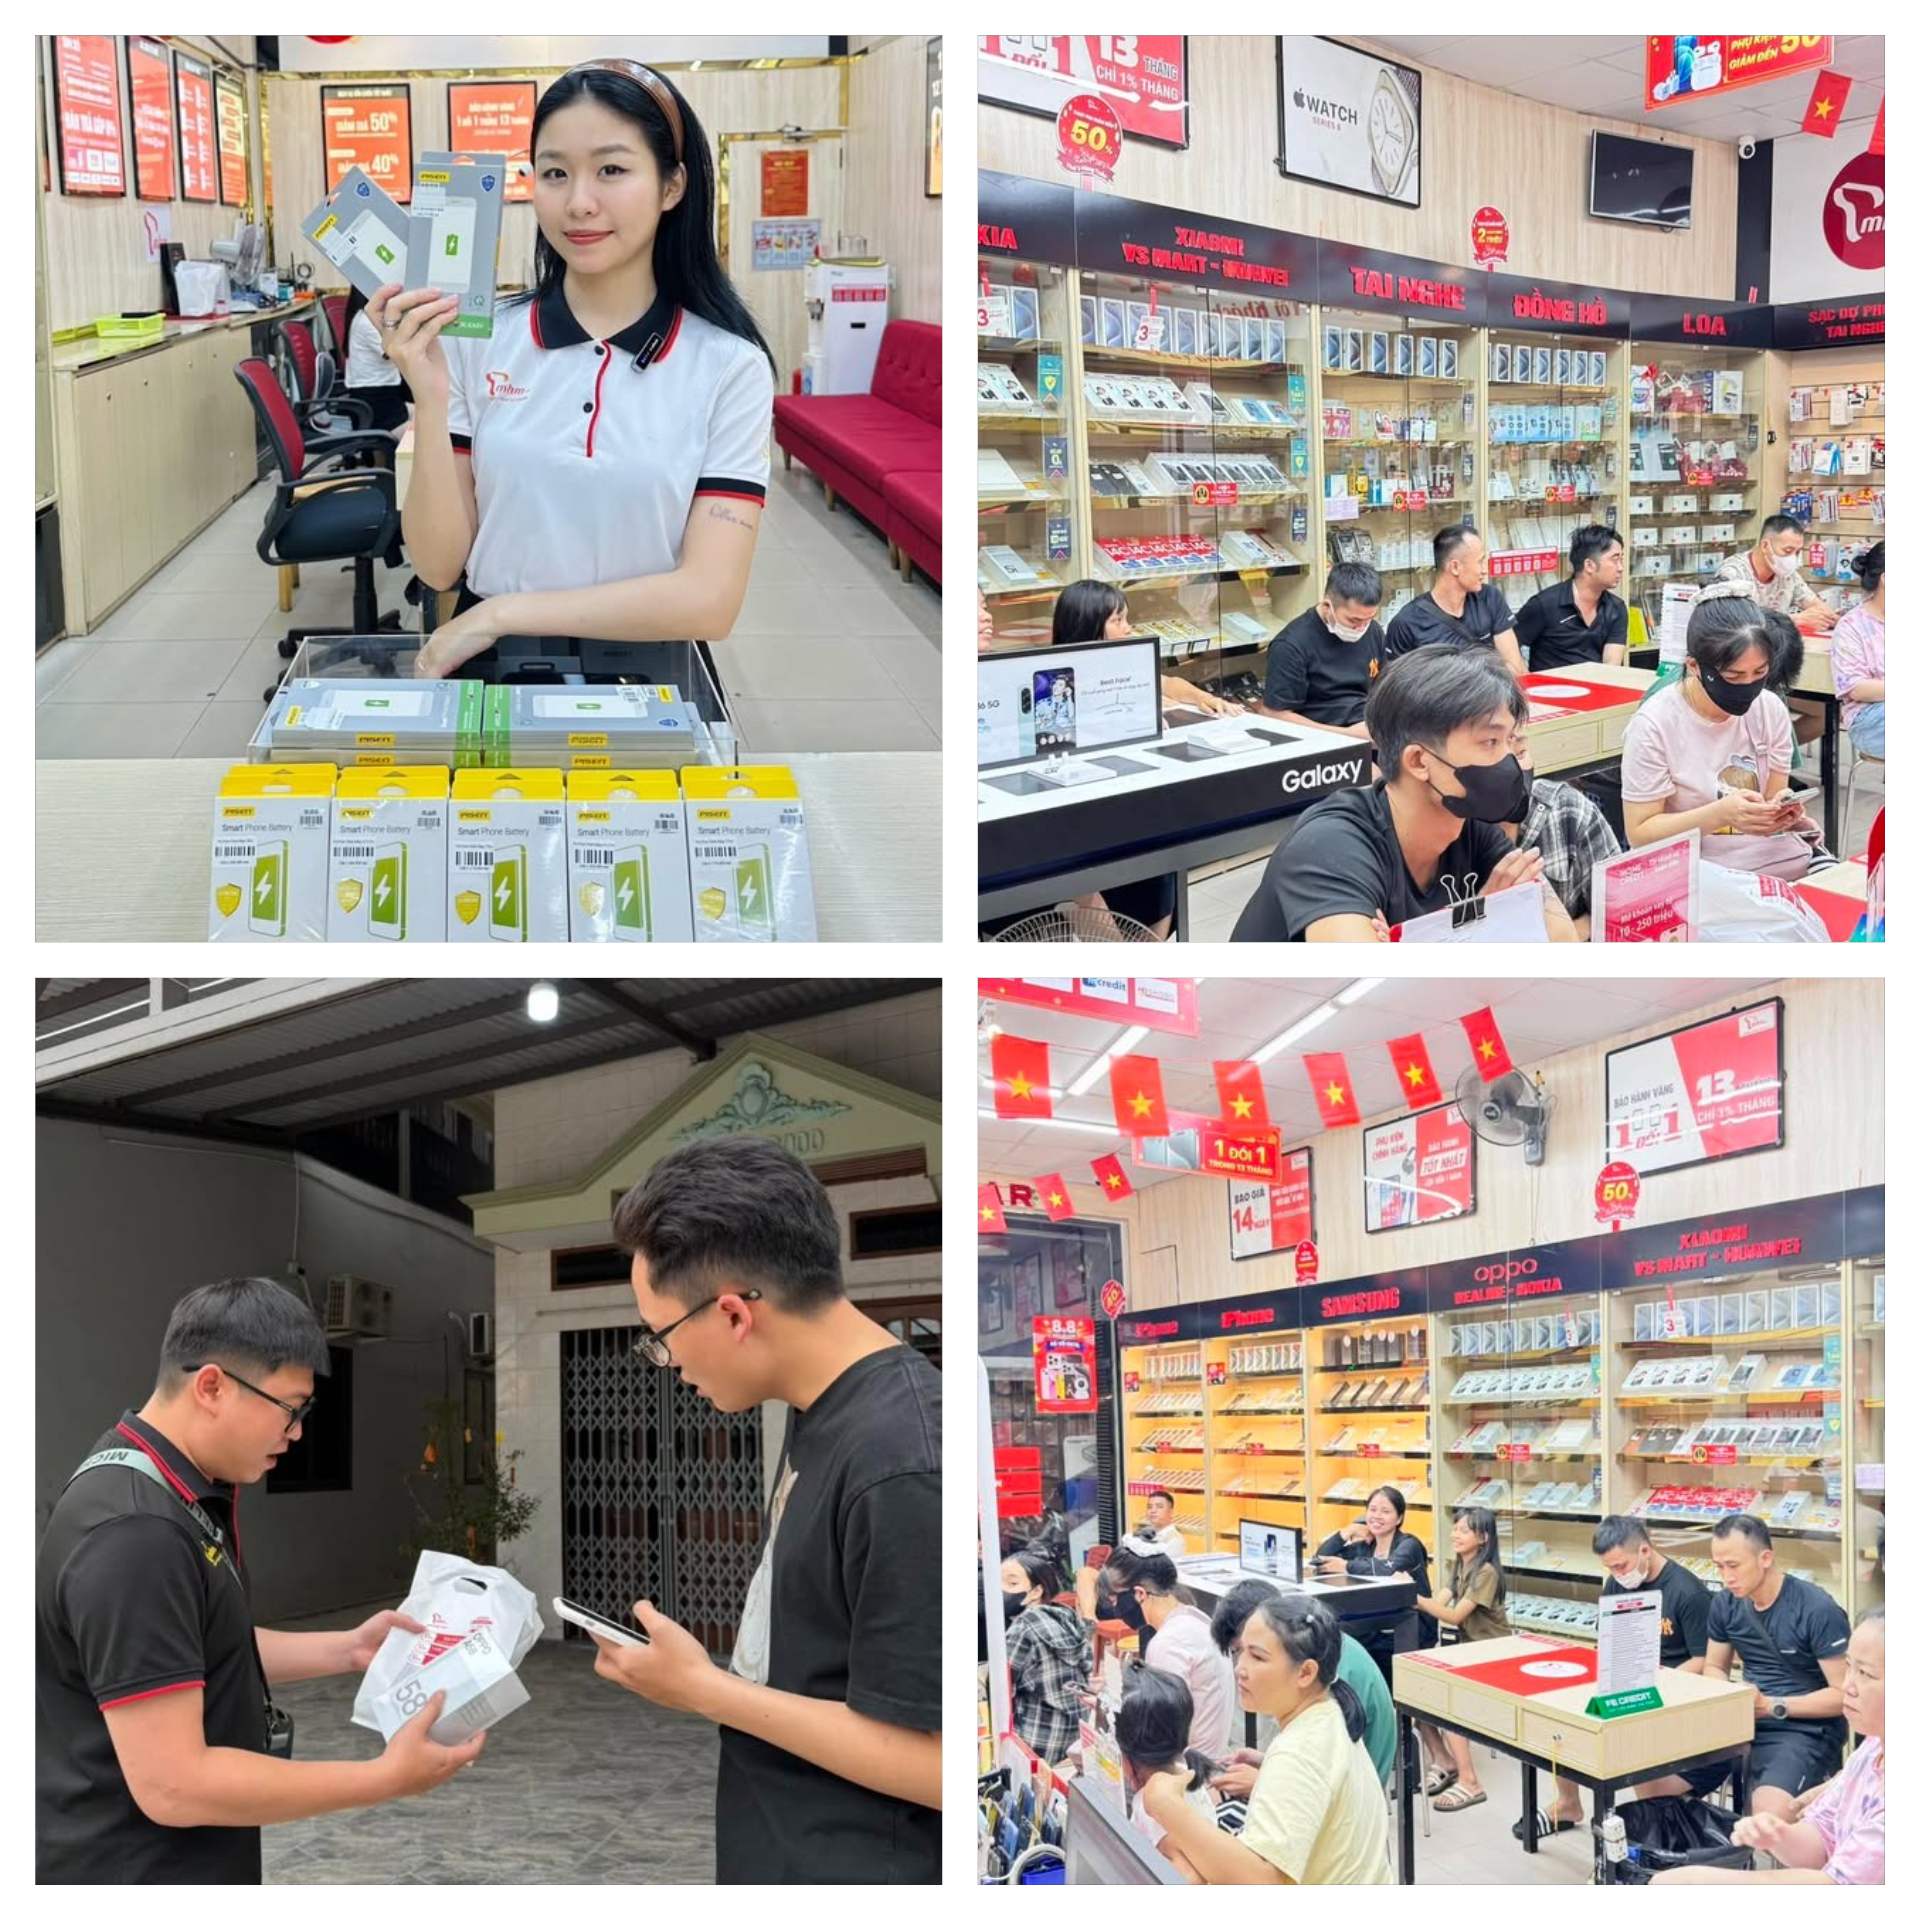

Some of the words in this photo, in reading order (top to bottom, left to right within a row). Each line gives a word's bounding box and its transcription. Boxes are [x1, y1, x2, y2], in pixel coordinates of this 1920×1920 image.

[1144, 56, 1178, 81] THÁNG
[1729, 53, 1756, 70] GIẢM
[1096, 65, 1117, 84] CHỈ
[1121, 73, 1137, 89] 1%
[1141, 78, 1179, 100] THÁNG
[1306, 95, 1357, 125] WATCH
[1312, 116, 1334, 130] SERIES
[1174, 226, 1244, 256] XIAOMI
[1350, 266, 1393, 299] TAI
[1398, 276, 1466, 311] NGHE
[1513, 287, 1577, 322] ĐỒNG
[1579, 297, 1607, 326] HỒ
[1809, 308, 1835, 325] SẠC
[1683, 313, 1726, 336] LOA
[1827, 324, 1847, 338] TAI
[1281, 759, 1363, 793] Galaxy
[222, 824, 243, 833] Smart
[244, 824, 267, 832] Phone
[268, 824, 292, 834] Battery
[340, 825, 361, 834] Smart
[363, 826, 385, 834] Phone
[387, 826, 411, 835] Battery
[458, 827, 479, 836] Smart
[481, 828, 503, 836] Phone
[505, 828, 530, 837] Battery
[577, 828, 599, 837] Smart
[601, 828, 623, 836] Phone
[625, 827, 650, 838] Battery
[699, 826, 720, 835] Smart
[722, 826, 744, 835] Phone
[746, 826, 771, 836] Battery
[1636, 917, 1652, 931] 250
[1097, 979, 1126, 991] credit
[1696, 1069, 1736, 1107] 13
[1214, 1139, 1224, 1158] 1
[1229, 1147, 1252, 1162] ĐỔI
[1256, 1146, 1266, 1164] 1
[1423, 1157, 1439, 1174] TỐT
[1440, 1151, 1465, 1169] NHẤT
[1233, 1205, 1253, 1234] 14
[1680, 1224, 1748, 1250] XIAOMI
[1321, 1287, 1400, 1318] SAMSUNG
[1051, 1320, 1076, 1333] 8.8
[396, 1680, 427, 1716] 58
